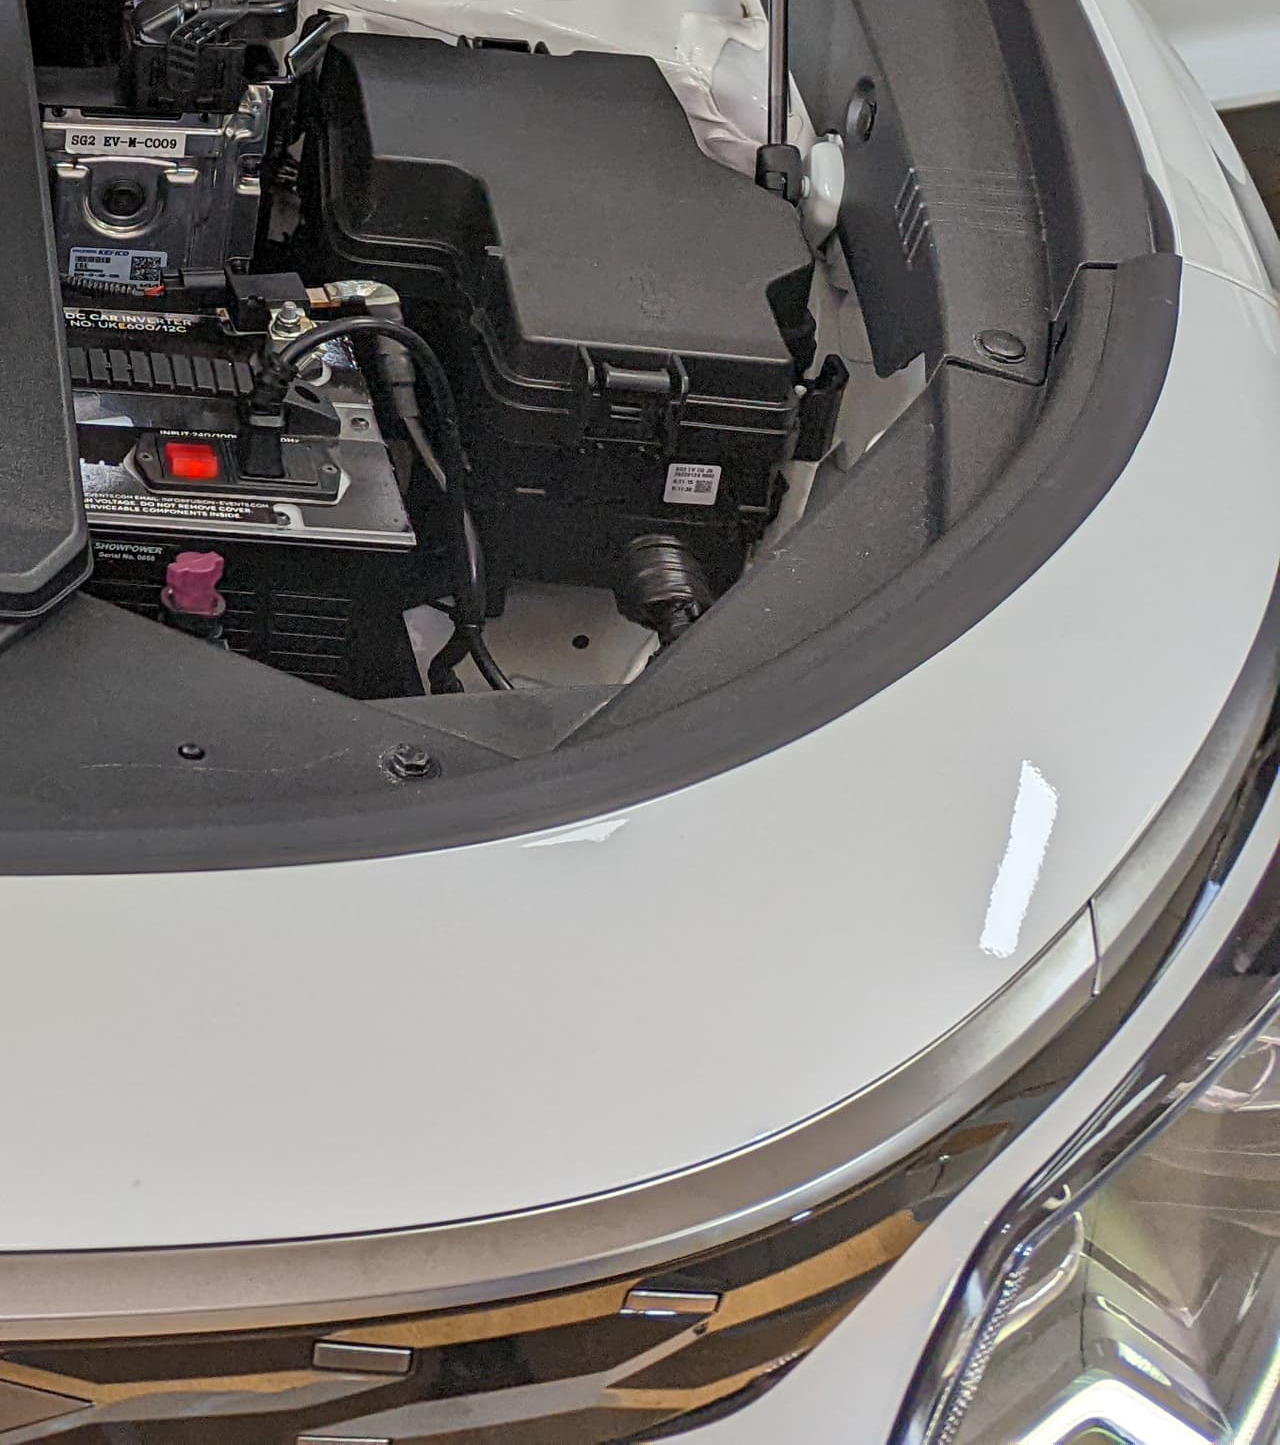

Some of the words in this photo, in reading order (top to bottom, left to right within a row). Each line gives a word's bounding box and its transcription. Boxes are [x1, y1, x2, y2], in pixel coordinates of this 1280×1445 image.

[71, 135, 96, 146] SG2
[89, 314, 118, 322] CAR
[122, 315, 192, 326] INVERTER
[98, 321, 187, 333] UKE600/12C
[142, 507, 209, 517] COMPONENTS
[178, 503, 217, 511] REMOVE
[94, 542, 163, 554] SHOWPOWER
[98, 551, 120, 559] Serial
